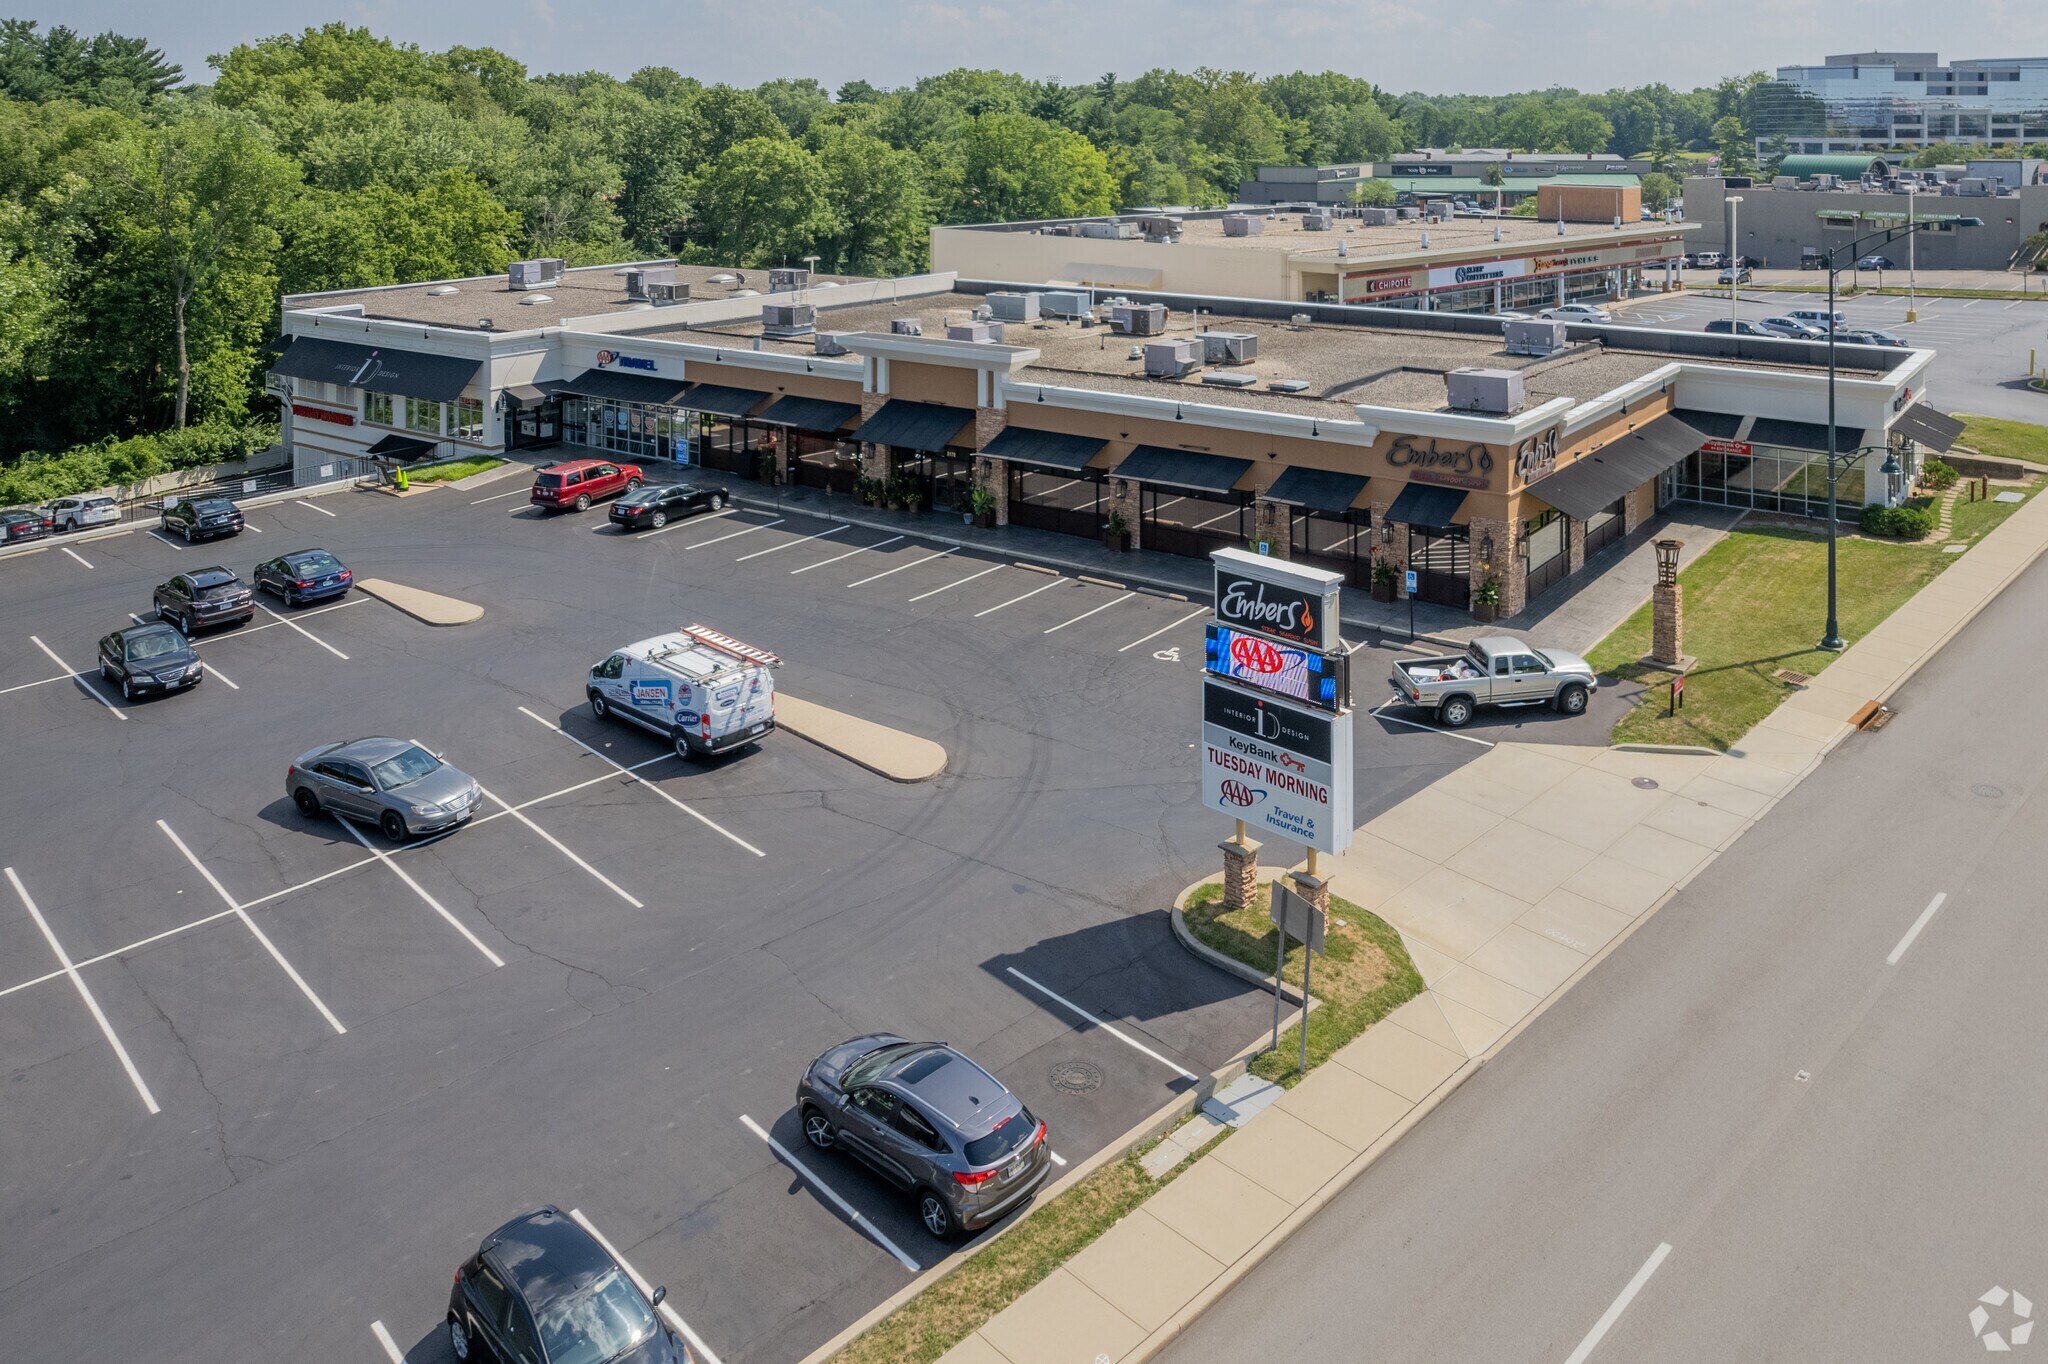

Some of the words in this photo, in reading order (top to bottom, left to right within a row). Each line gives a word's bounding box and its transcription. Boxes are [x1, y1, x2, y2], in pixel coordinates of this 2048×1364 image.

[1378, 277, 1412, 290] CHIPOTLE
[377, 370, 400, 378] DESIGN
[1386, 435, 1482, 474] Embers
[1220, 581, 1302, 630] Embers
[1233, 638, 1281, 672] AAA
[637, 688, 666, 698] JANSEN
[677, 713, 698, 723] Carrier
[1223, 707, 1256, 723] INTERIOR
[1281, 726, 1310, 741] DESIGN
[1229, 736, 1278, 762] KeyBank
[1207, 746, 1262, 780] TUESDAY
[1265, 768, 1328, 805] MORNING
[1222, 780, 1252, 807] AAA
[1266, 814, 1315, 840] Insurance
[1274, 805, 1304, 825] Travel
[1306, 818, 1315, 829] &
